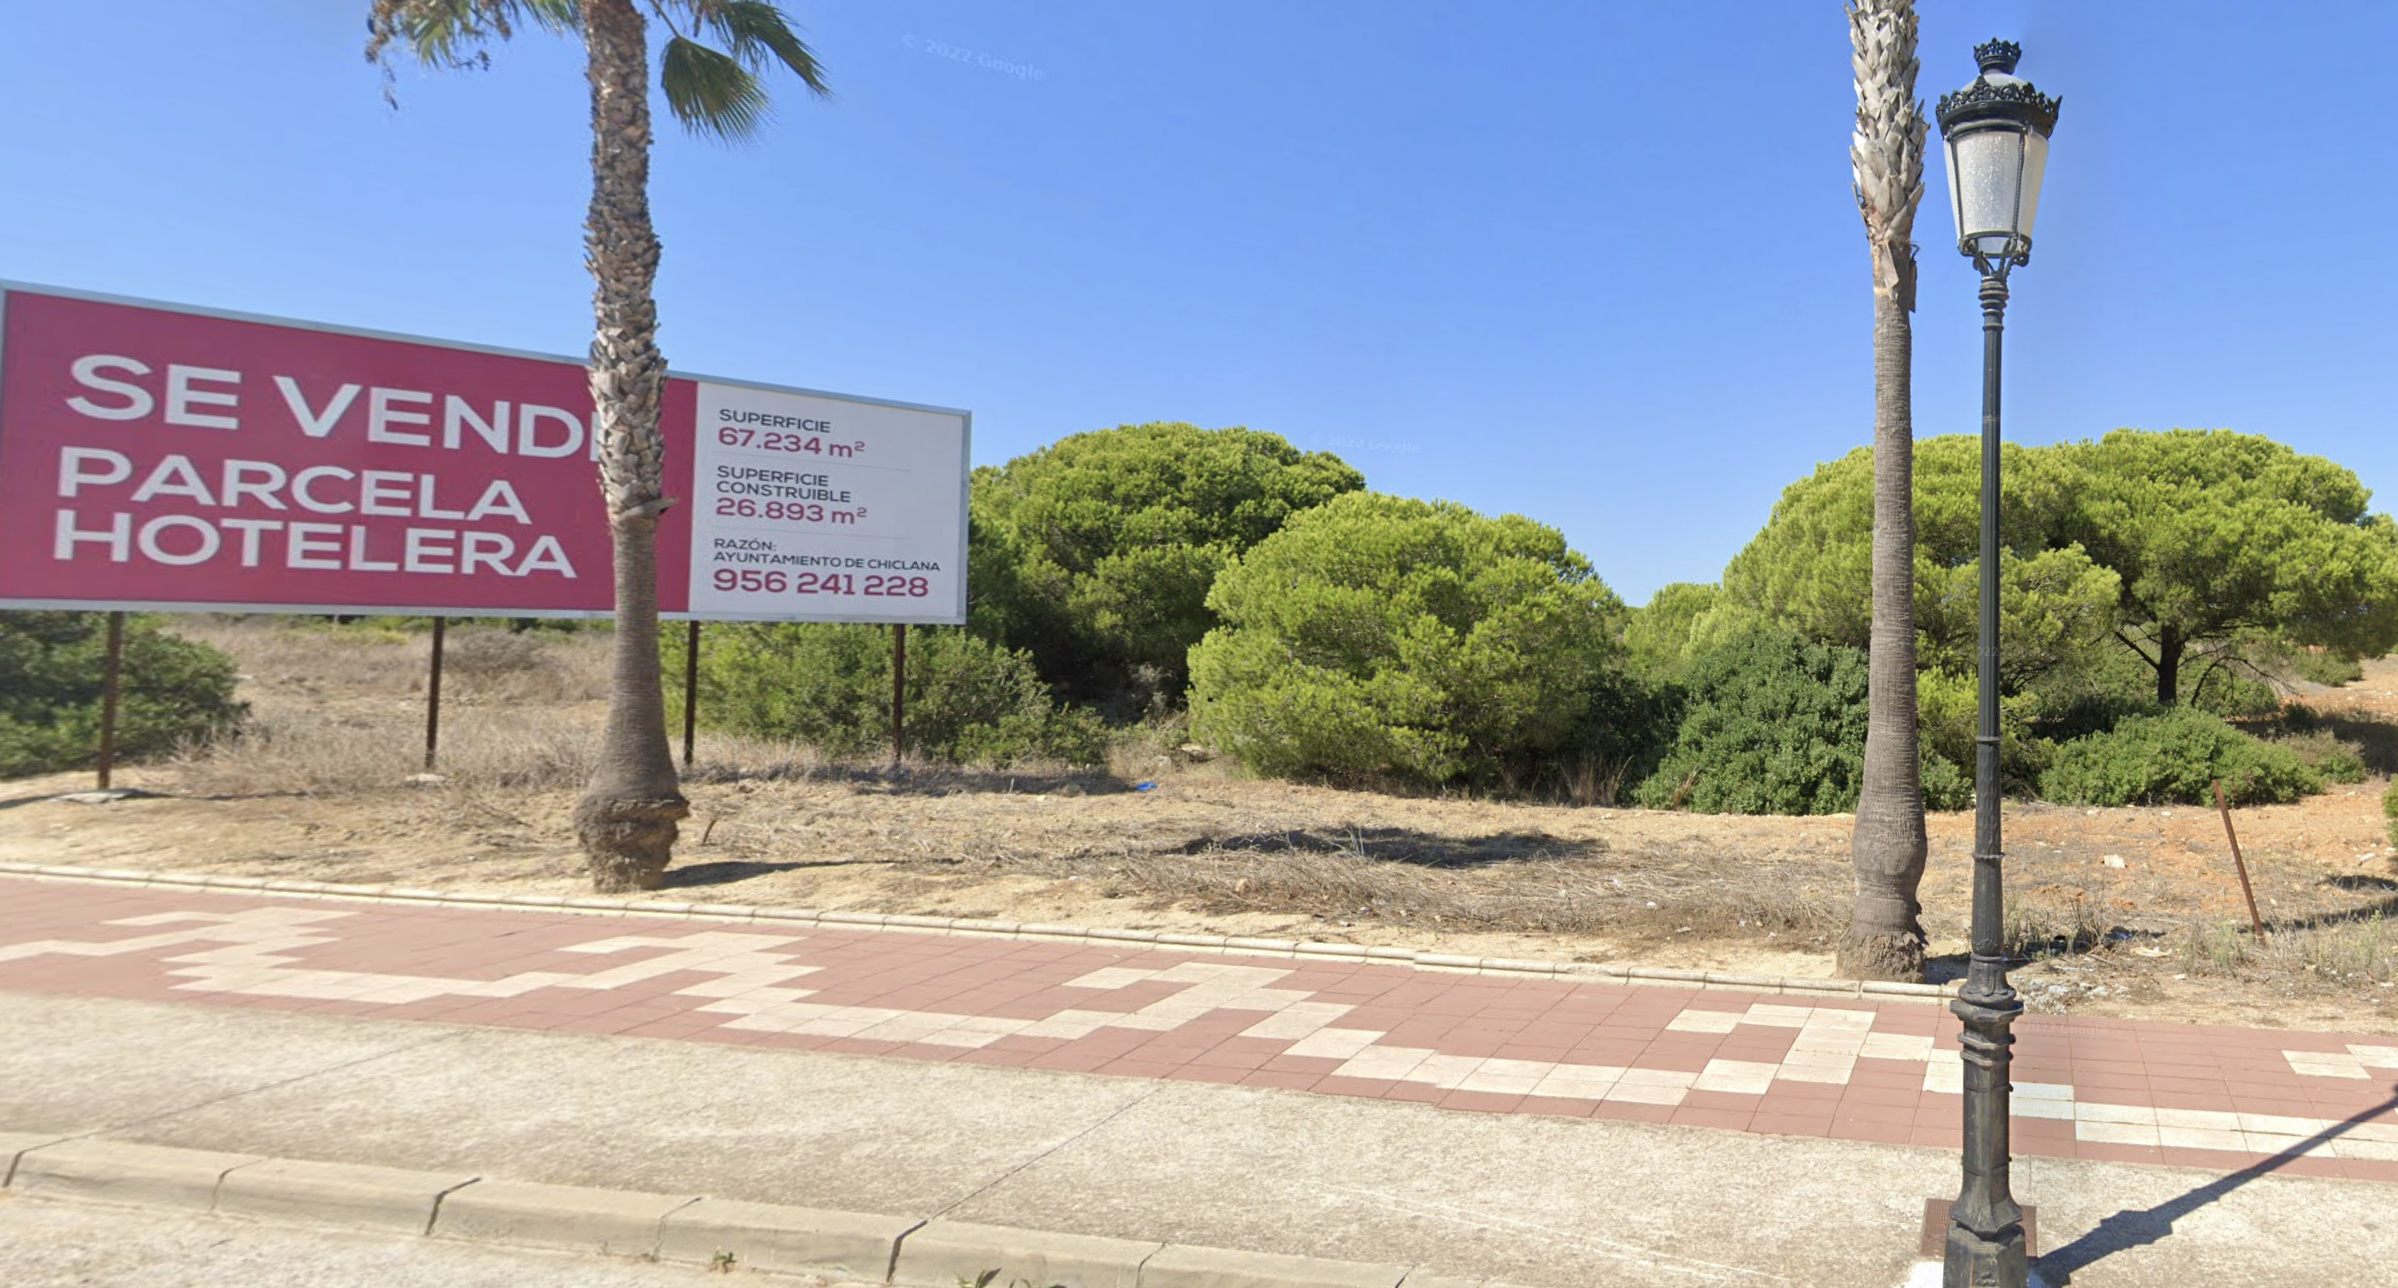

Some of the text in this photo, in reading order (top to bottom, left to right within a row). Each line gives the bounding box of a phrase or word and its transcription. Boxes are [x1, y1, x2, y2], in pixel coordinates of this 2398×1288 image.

[66, 355, 241, 430] SE
[719, 408, 831, 433] SUPERFICIE
[718, 426, 823, 455] 67.234
[58, 446, 532, 524] PARCELA
[716, 464, 829, 487] SUPERFICIE
[716, 480, 852, 503] CONSTRUIBLE
[715, 496, 825, 523] 26.893
[53, 508, 578, 579] HOTELERA
[713, 537, 777, 552] RAZÓN:
[712, 550, 941, 571] AYUNTAMIENTO DE CHICLANA
[712, 567, 930, 598] 956 241 228
